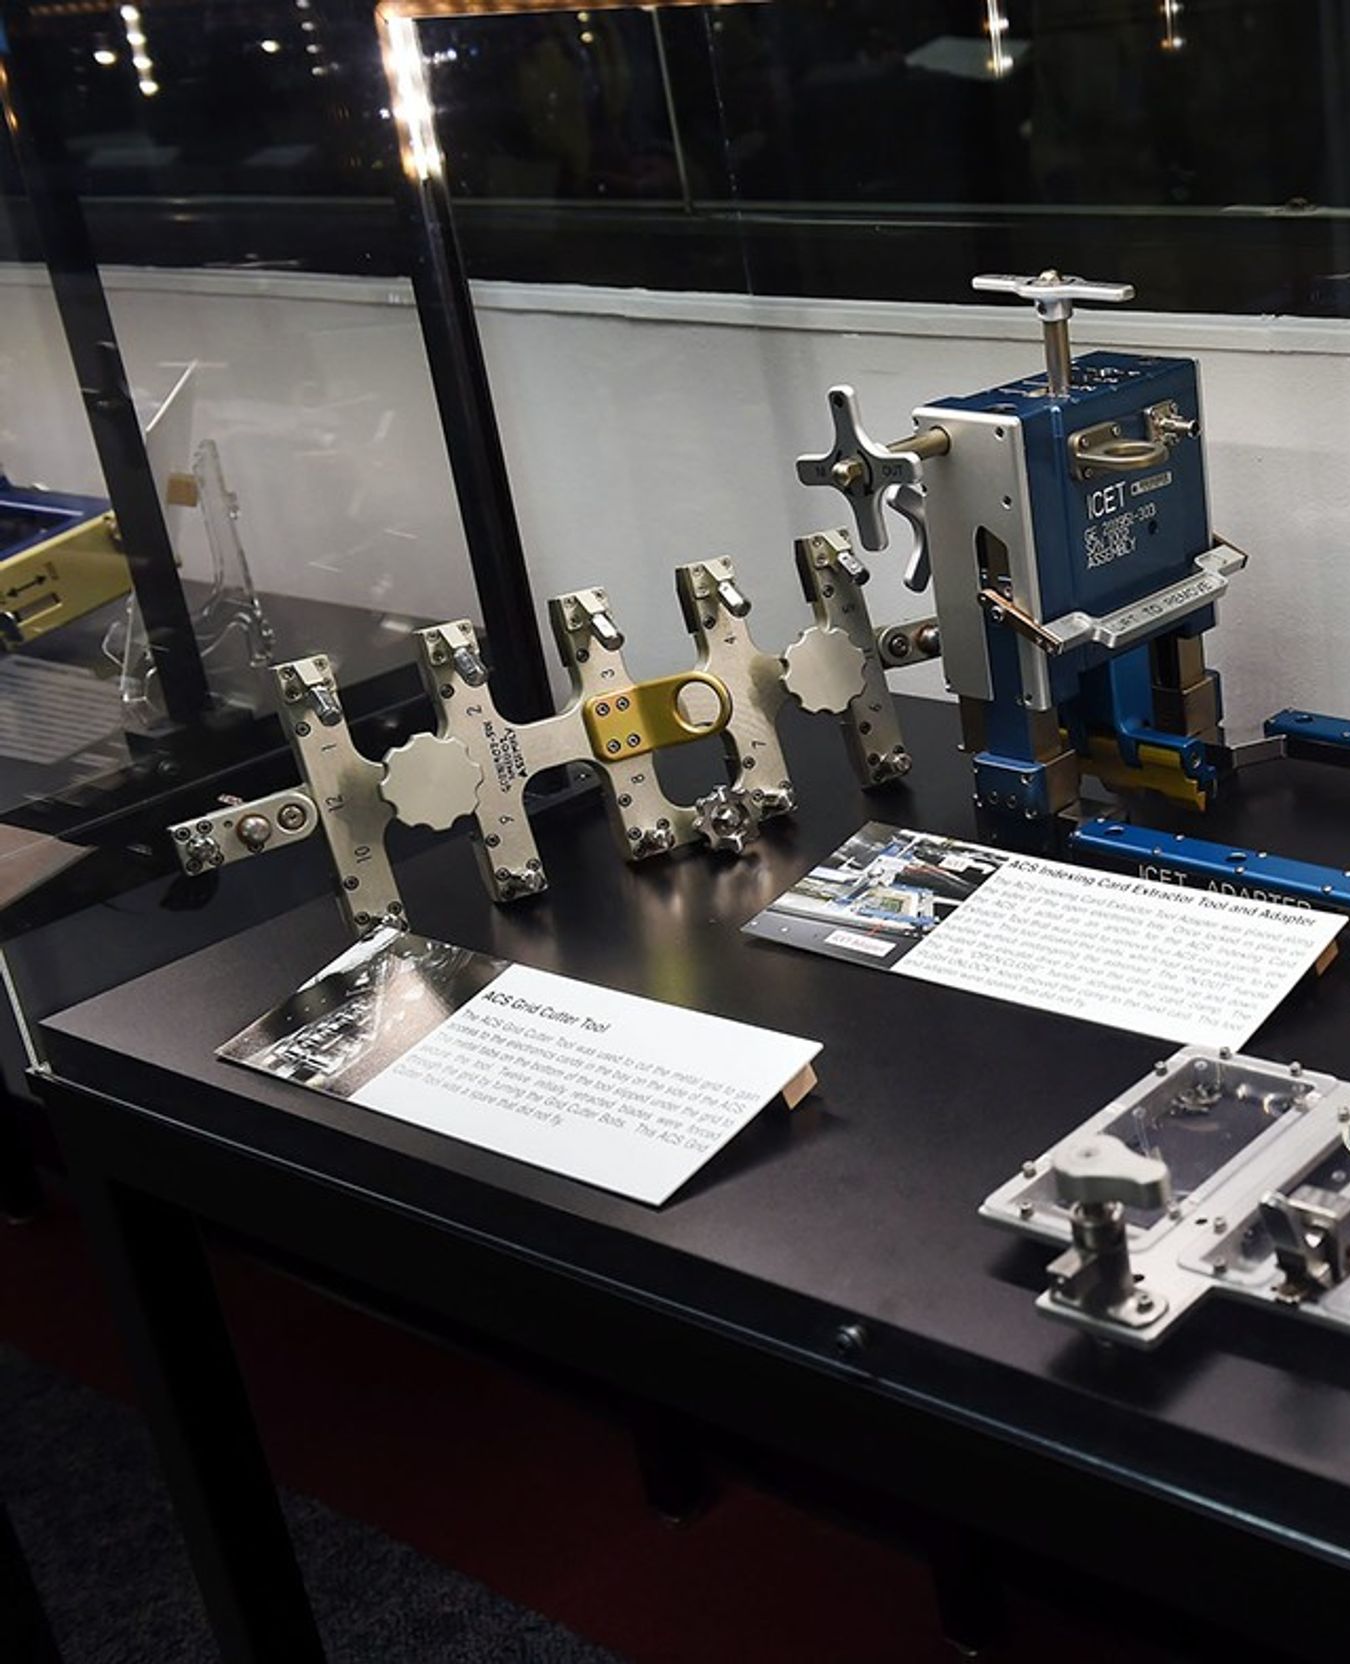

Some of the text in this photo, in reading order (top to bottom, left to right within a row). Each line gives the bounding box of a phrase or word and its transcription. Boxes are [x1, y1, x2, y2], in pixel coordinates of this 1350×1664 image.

[1087, 481, 1126, 519] ICET
[1087, 536, 1136, 569] ASSEMBLY
[724, 636, 736, 644] 4
[601, 668, 615, 679] 3
[466, 704, 482, 716] 2
[321, 744, 337, 752] 1
[752, 740, 766, 749] 7
[631, 773, 645, 784] 8
[326, 795, 344, 813] 12
[354, 846, 372, 864] 10
[1007, 860, 1315, 925] ACS Indexing Card Extractor Tool and Adapter
[481, 990, 610, 1032] ACS Grid Cutter Tool
